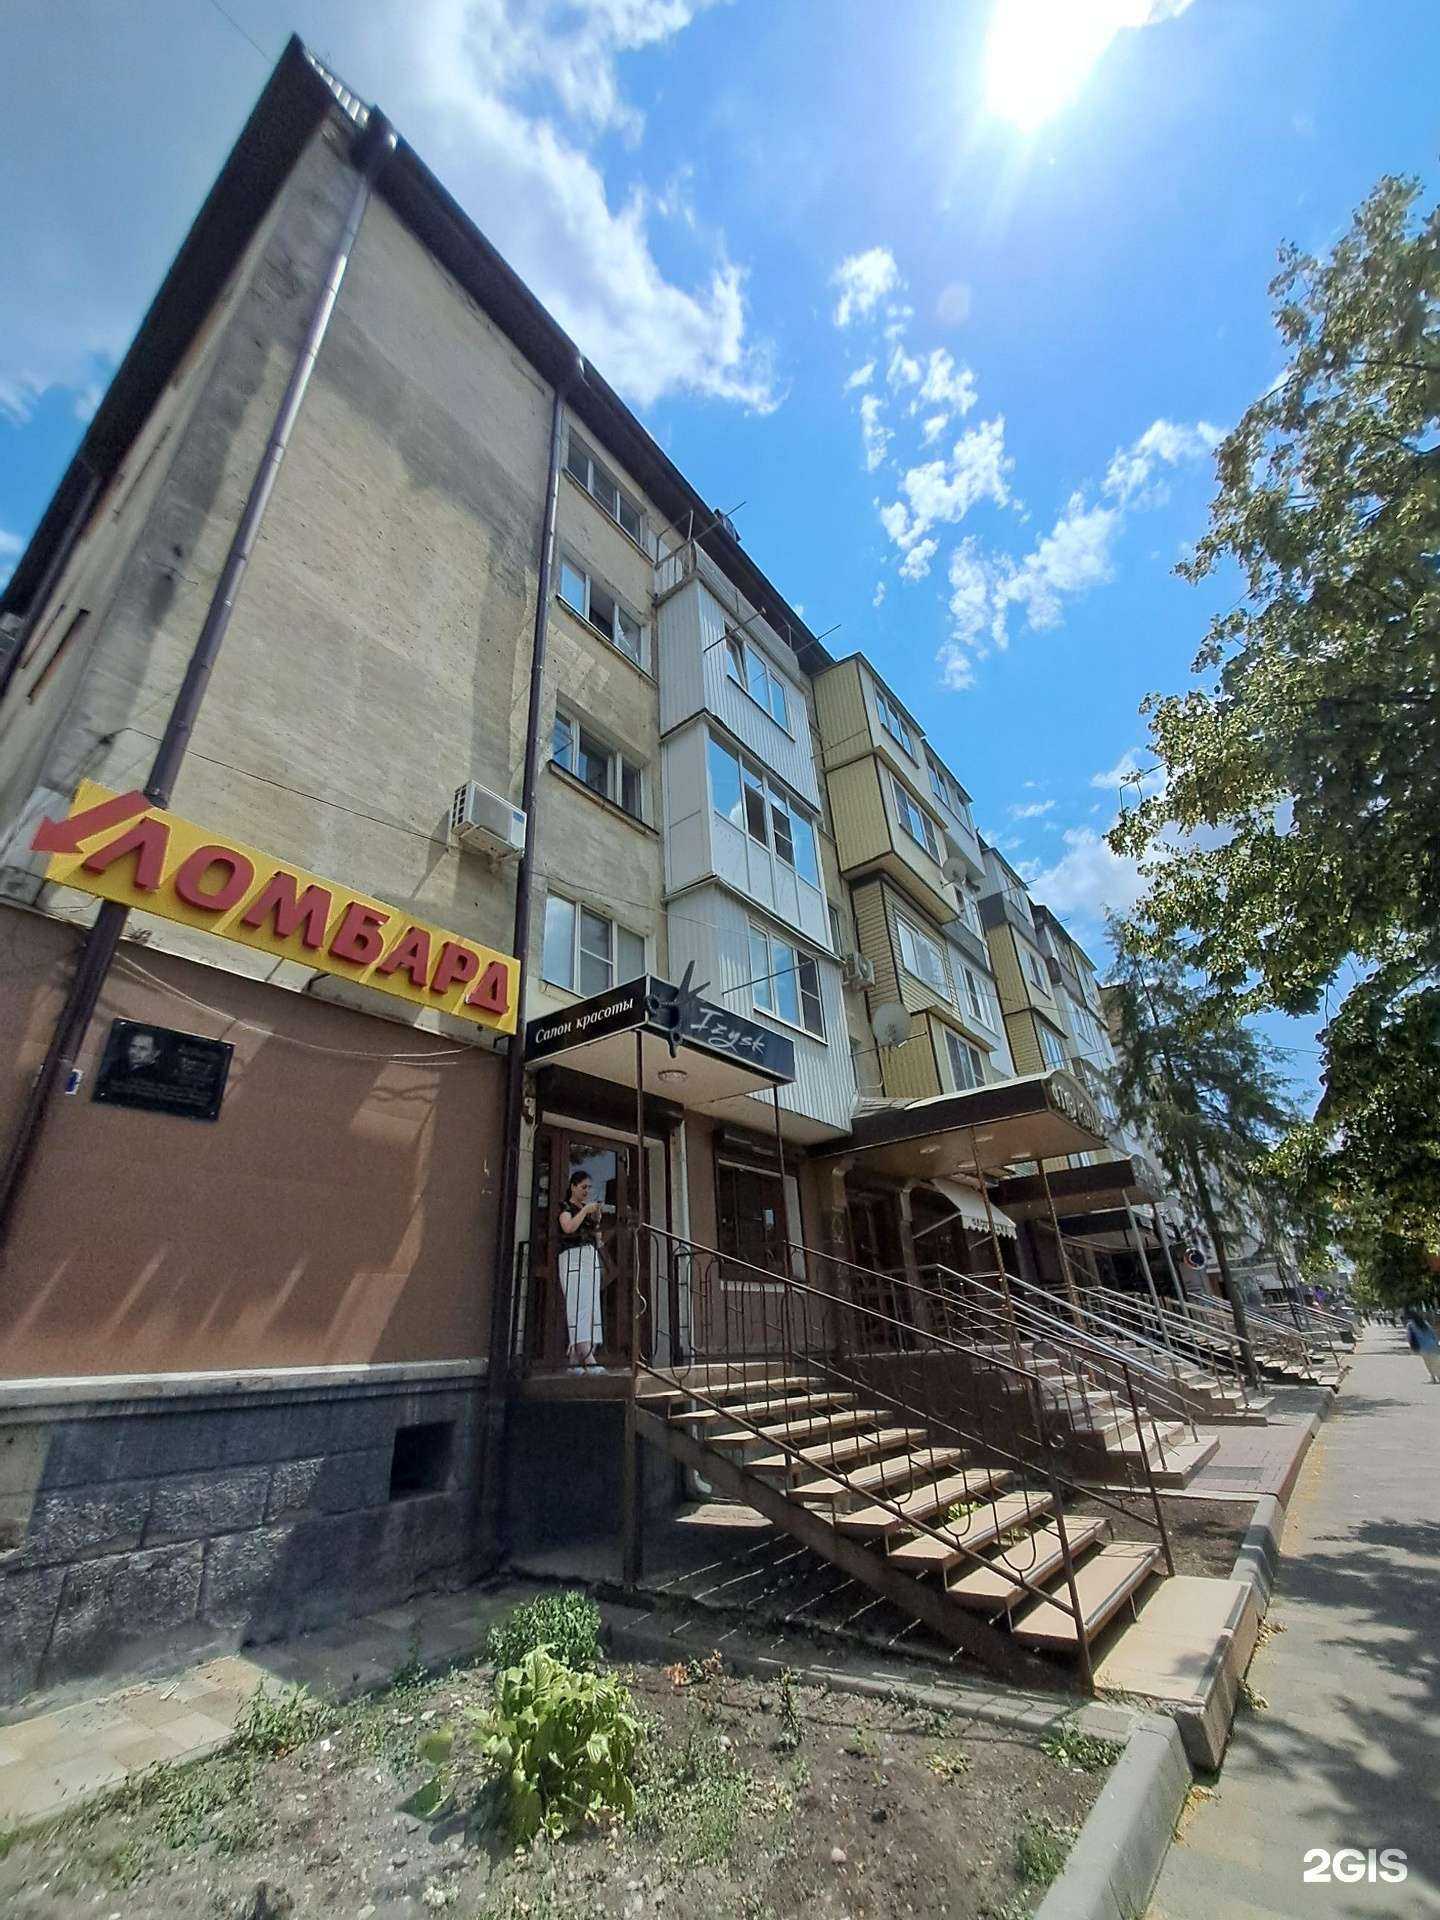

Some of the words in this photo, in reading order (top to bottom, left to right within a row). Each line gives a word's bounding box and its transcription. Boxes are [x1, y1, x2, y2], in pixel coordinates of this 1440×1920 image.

[81, 817, 510, 1015] ЛОМБАРД
[536, 1023, 572, 1044] Салон
[576, 997, 634, 1031] красоты
